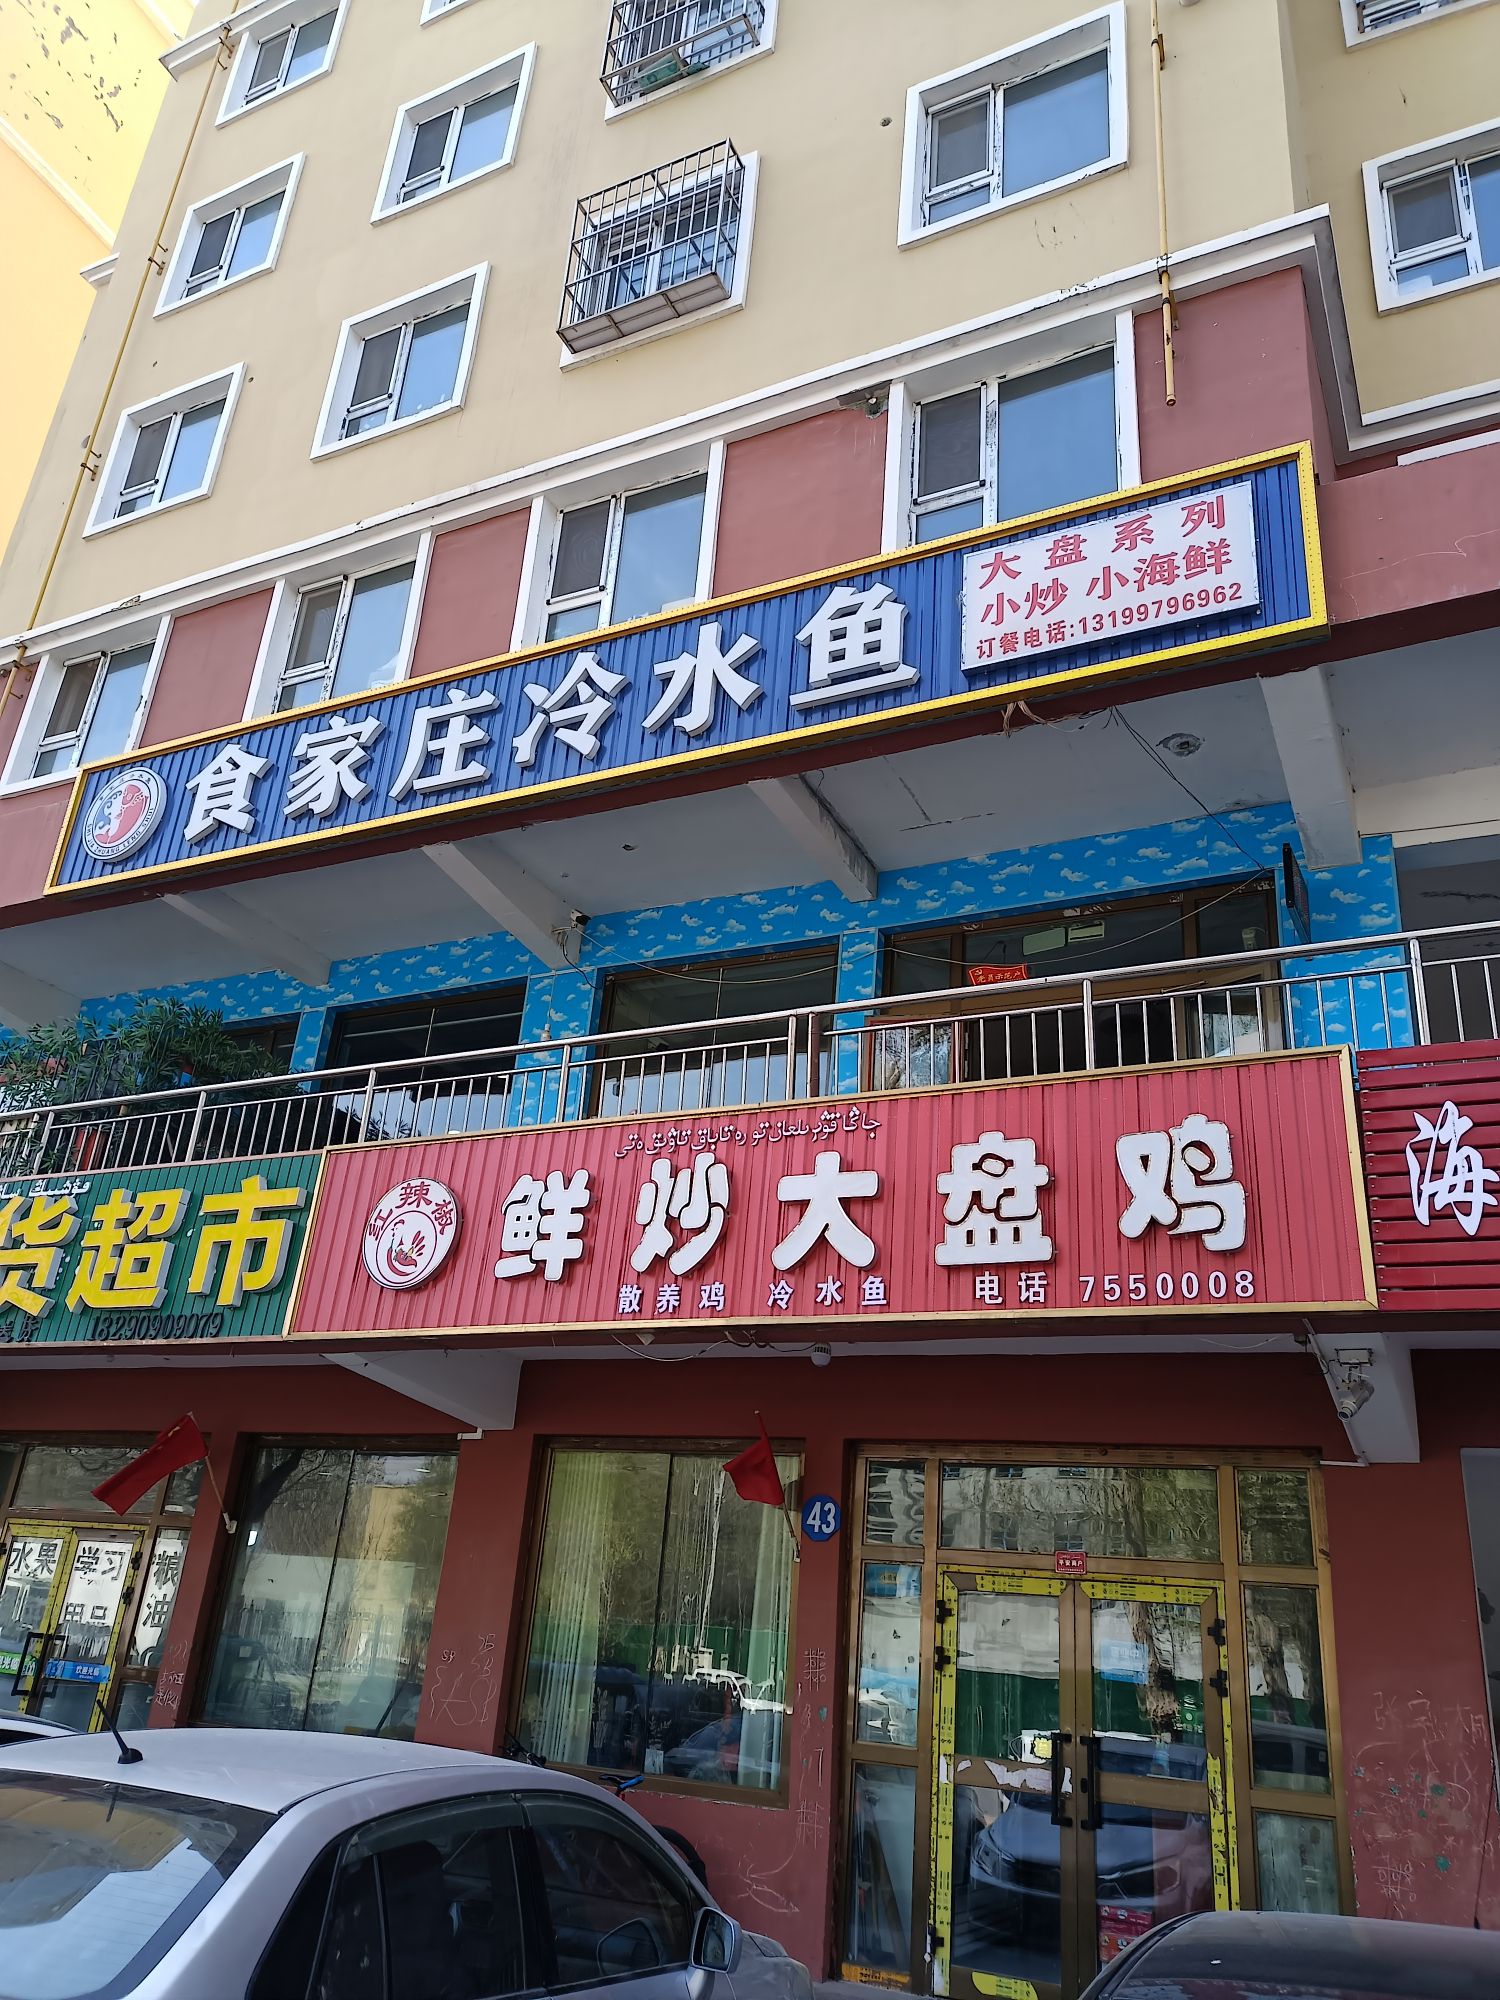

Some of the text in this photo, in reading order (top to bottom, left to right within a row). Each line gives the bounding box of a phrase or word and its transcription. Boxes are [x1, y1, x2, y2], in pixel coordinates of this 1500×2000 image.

[979, 494, 1226, 590] 大盘系列
[980, 538, 1232, 626] 小炒 小海鲜
[184, 582, 921, 845] 食家庄冷水鱼
[494, 1114, 1248, 1283] 鲜炒大盘鸡
[1405, 1100, 1500, 1236] 海
[368, 1181, 454, 1241] 红辣椒
[617, 1270, 1255, 1314] 散养鸡 冷水鱼 电话 7550008
[806, 1501, 836, 1534] 43
[9, 1541, 58, 1576] 水果
[73, 1545, 127, 1582] 学习
[142, 1549, 181, 1629] 粮油
